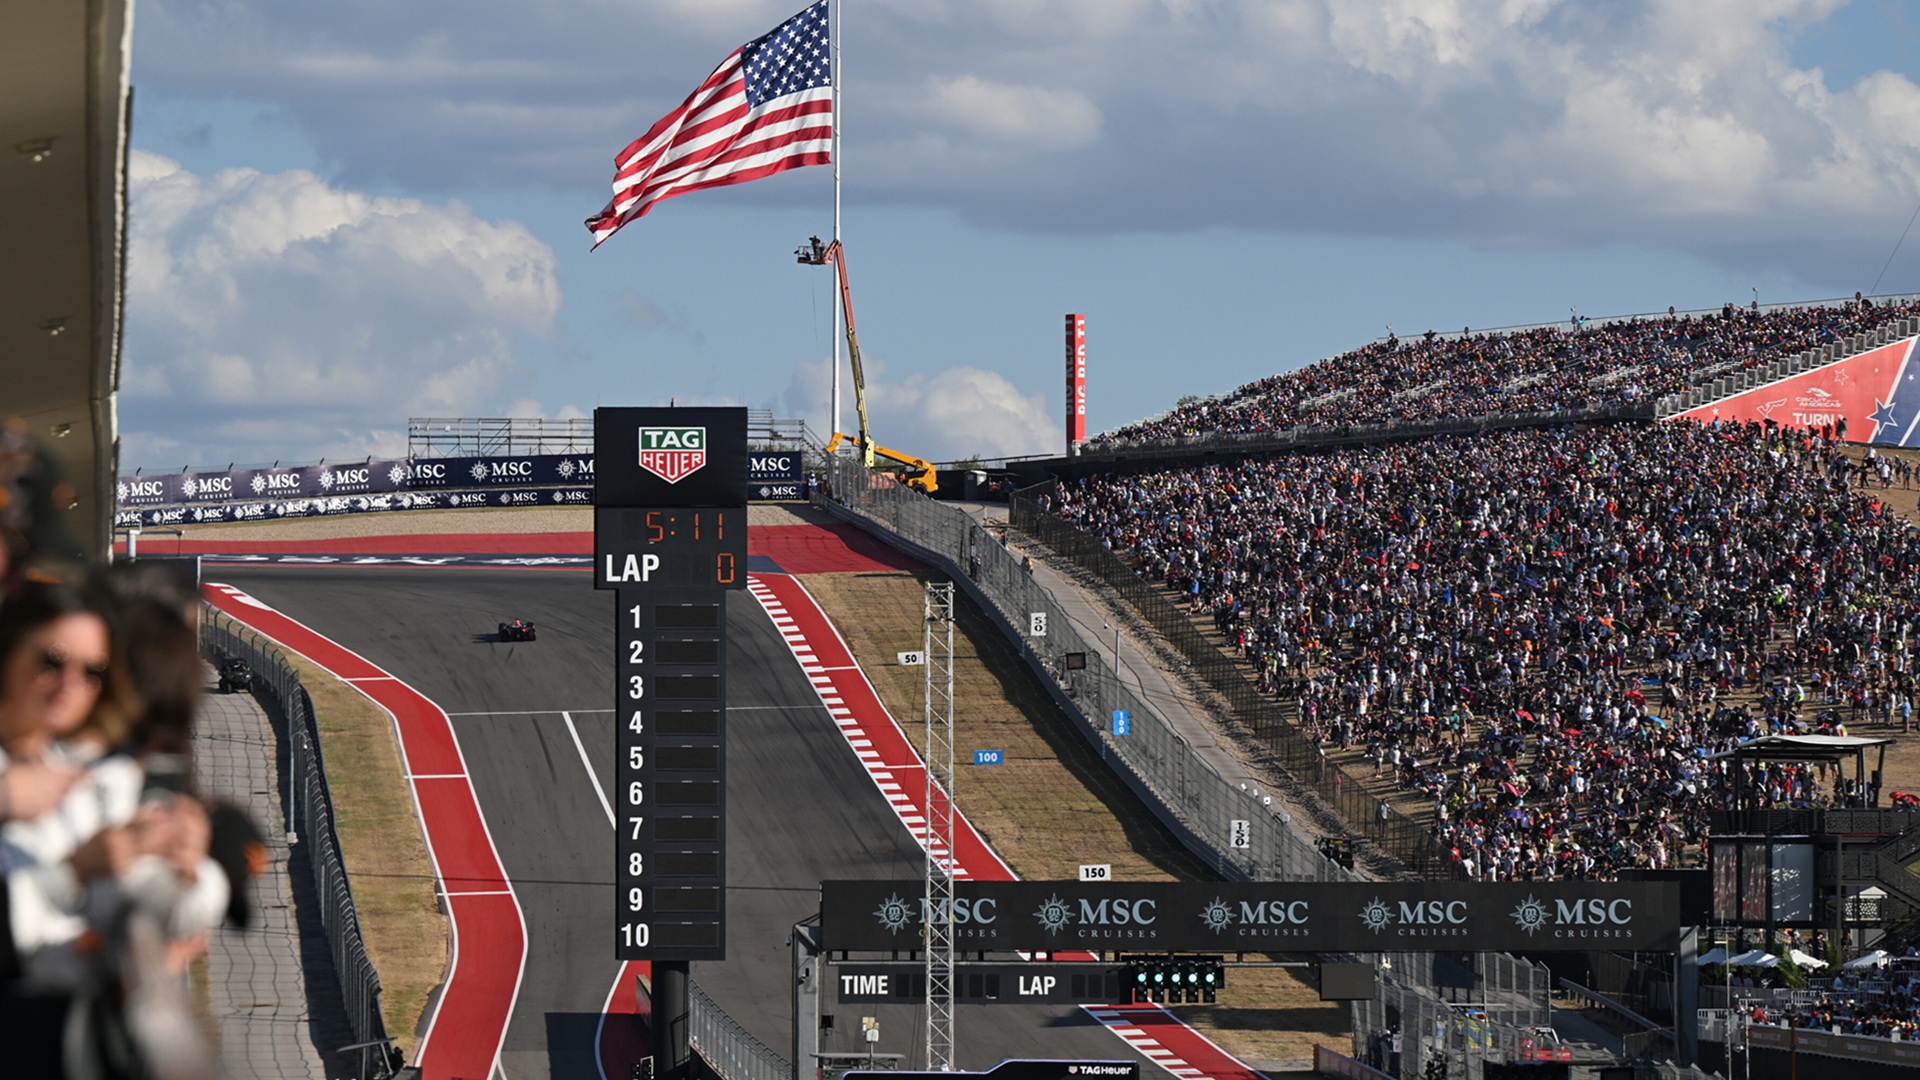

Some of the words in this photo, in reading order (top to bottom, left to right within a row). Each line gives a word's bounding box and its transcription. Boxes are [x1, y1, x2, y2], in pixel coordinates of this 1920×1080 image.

[1792, 412, 1835, 426] TURN
[645, 431, 699, 448] TAG
[406, 464, 445, 479] MSC
[491, 461, 532, 476] MSC
[643, 453, 701, 480] HEUER
[750, 457, 791, 471] MSC
[199, 477, 232, 492] MSC
[267, 473, 300, 488] MSC
[336, 469, 369, 484] MSC
[130, 481, 163, 496] MSC
[512, 492, 538, 501] MSC
[565, 491, 590, 500] MSC
[772, 486, 796, 496] MSC
[462, 493, 486, 503] MSC
[203, 508, 223, 518] MSC
[646, 512, 722, 542] 5:11
[606, 554, 660, 582] LAP
[717, 553, 734, 583] 0
[630, 605, 640, 628] 1
[629, 640, 644, 664] 2
[904, 654, 917, 664] 50
[629, 676, 644, 699] 3
[629, 711, 644, 734] 4
[629, 746, 644, 770] 5
[978, 752, 998, 764] 100
[629, 782, 644, 805] 6
[629, 817, 644, 840] 7
[629, 852, 644, 876] 8
[1084, 867, 1105, 879] 150
[629, 888, 644, 912] 9
[918, 898, 997, 925] MSC
[1078, 899, 1156, 925] MSC
[1239, 901, 1309, 924] MSC
[1398, 901, 1467, 924] MSC
[1554, 899, 1632, 925] MSC
[620, 923, 649, 947] 10
[1078, 930, 1156, 938] CRUISES
[1239, 928, 1309, 936] CRUISES
[1398, 928, 1468, 936] CRUISES
[1554, 930, 1632, 938] CRUISES
[841, 975, 888, 995] TIME
[1019, 976, 1056, 995] LAP
